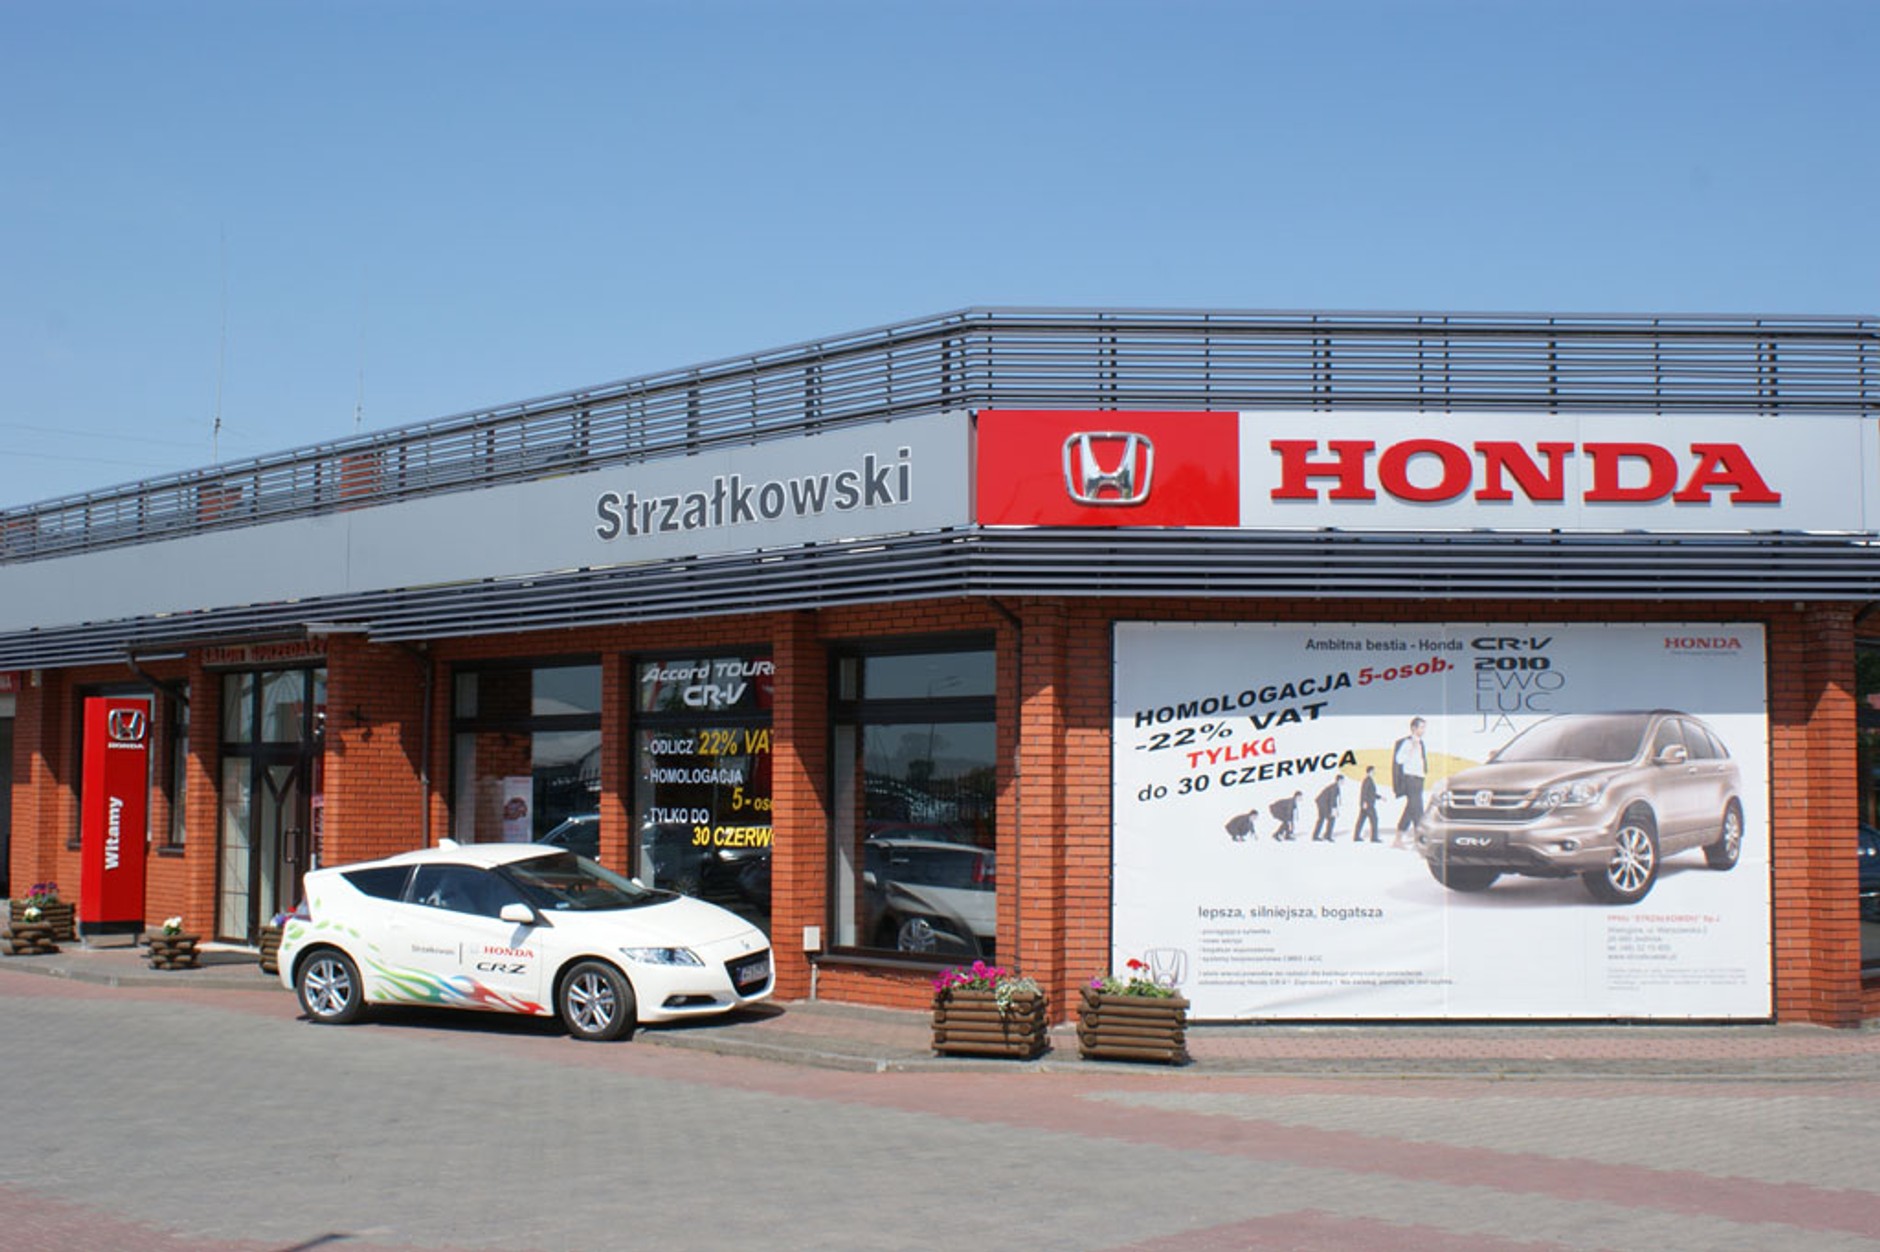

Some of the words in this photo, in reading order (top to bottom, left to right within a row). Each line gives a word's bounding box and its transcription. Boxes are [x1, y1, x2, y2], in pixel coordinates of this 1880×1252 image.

[1270, 439, 1782, 504] HONDA
[596, 446, 912, 540] Strzałkowski
[1305, 638, 1362, 650] Ambitna
[1366, 638, 1407, 650] bestia
[1419, 638, 1463, 650] Honda
[1664, 637, 1742, 649] HONDA
[641, 663, 710, 682] Accord
[1474, 657, 1551, 671] 2010
[1476, 671, 1565, 691] EWO
[683, 682, 747, 706] CR-V
[1134, 672, 1352, 728] HOMOLOGACJA
[1358, 656, 1454, 686] 5-osob.
[1476, 692, 1550, 712] LUC
[1135, 721, 1233, 752] -22%
[1250, 702, 1328, 731] VAT
[1474, 713, 1517, 734] JA
[650, 739, 694, 755] ODLICZ
[698, 729, 738, 755] 22%
[650, 768, 743, 784] HOMOLOGACJA
[1138, 784, 1168, 802] do
[1178, 774, 1210, 795] 30
[1219, 750, 1357, 787] CZERWCA
[650, 808, 688, 824] TYLKO
[691, 809, 709, 824] DO
[104, 796, 124, 870] Witamy
[692, 826, 710, 846] 30
[1198, 905, 1245, 919] lepsza,
[1250, 905, 1317, 919] silniejsza,
[1321, 905, 1383, 920] bogatsza
[484, 945, 535, 959] HONDA
